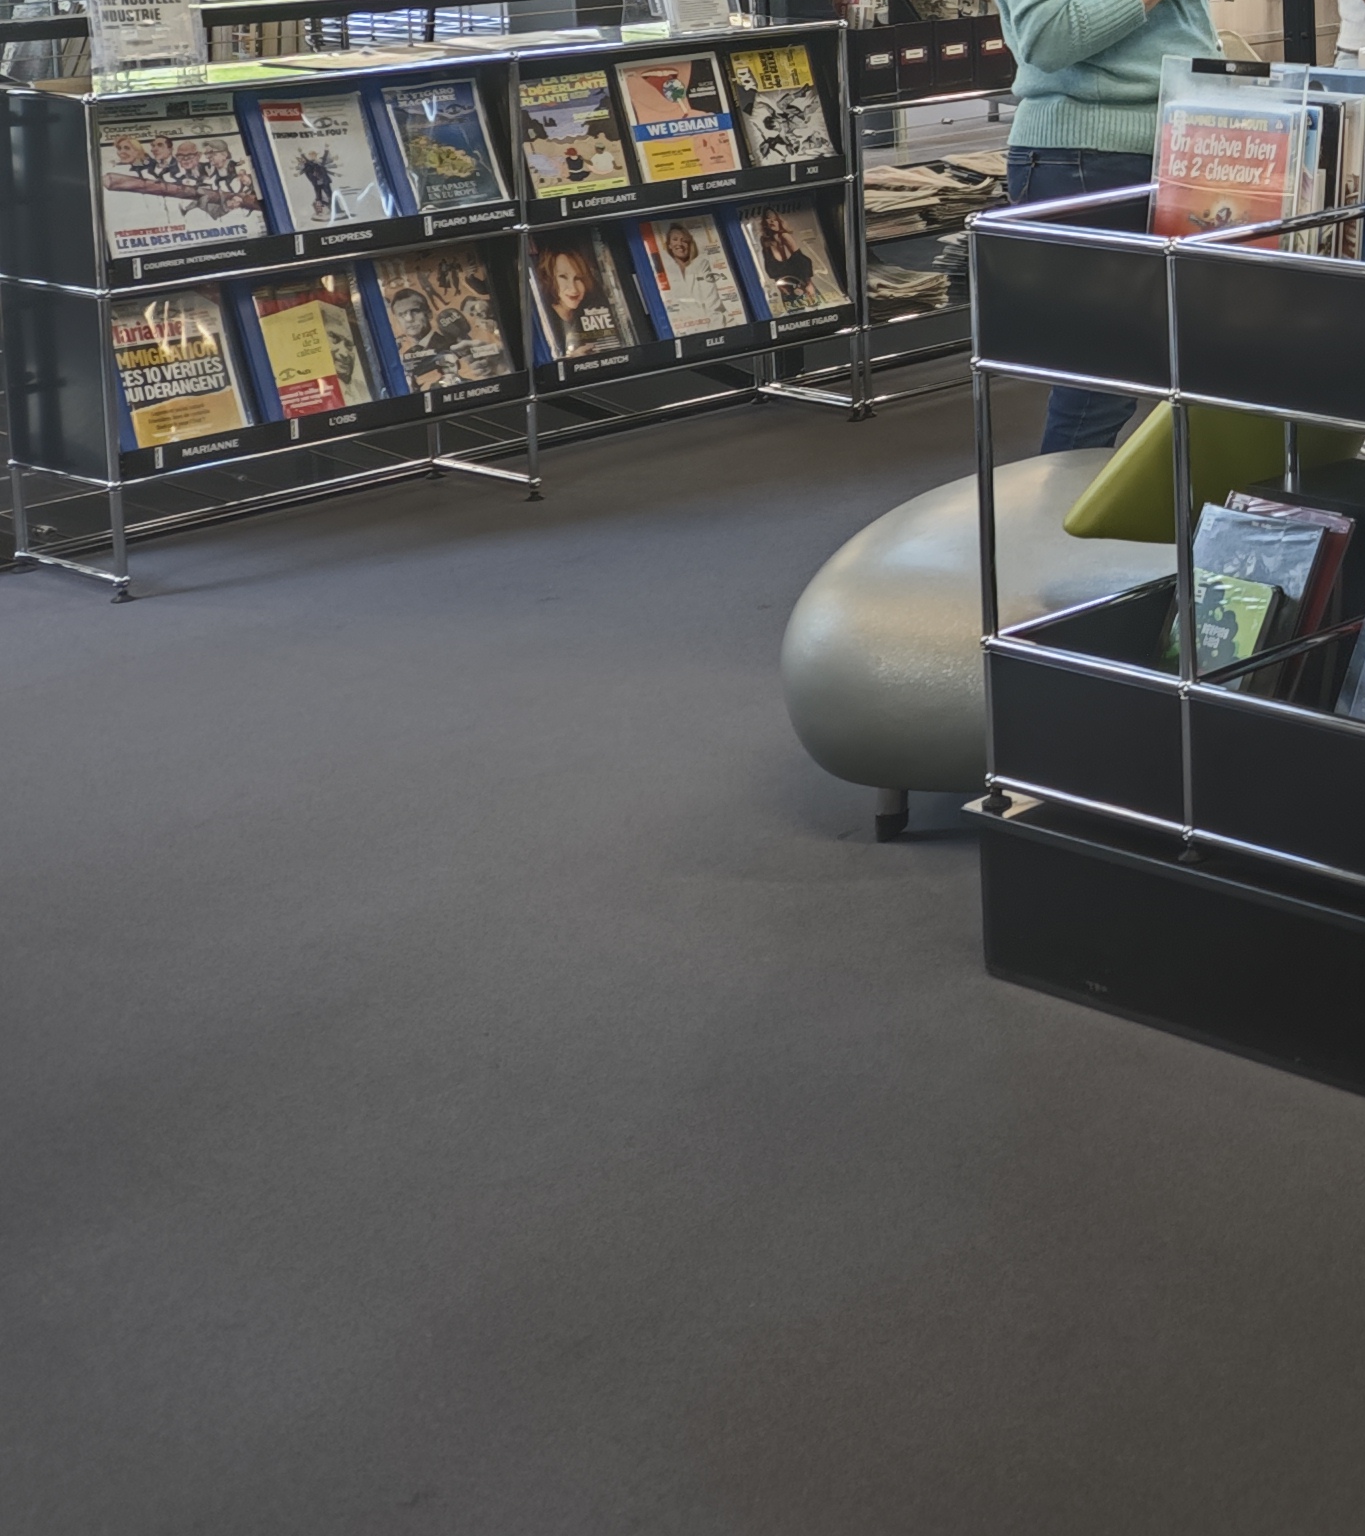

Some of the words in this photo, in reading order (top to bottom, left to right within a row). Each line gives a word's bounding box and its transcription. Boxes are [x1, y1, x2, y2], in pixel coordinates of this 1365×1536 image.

[646, 123, 668, 137] WE
[669, 116, 720, 134] DEMAIN
[1170, 131, 1190, 152] Un
[1193, 134, 1242, 158] achève
[1245, 136, 1277, 161] bien
[805, 166, 819, 175] XXI
[1168, 154, 1189, 176] les
[1191, 156, 1202, 178] 2
[1204, 159, 1262, 185] chevaux
[691, 183, 704, 192] WE
[705, 177, 737, 190] DEMAIN
[572, 199, 584, 209] LA
[585, 192, 637, 208] DÉFERLANTE
[433, 216, 467, 230] FIGARO
[468, 208, 515, 224] MAGAZINE
[321, 229, 373, 246] L'EXPRESS
[143, 258, 185, 271] COURRIER
[186, 249, 247, 265] INTERNATIONAL
[439, 312, 462, 328] Brut
[580, 313, 615, 332] BAYE
[778, 318, 811, 333] MADAME
[812, 313, 839, 327] FIGARO
[706, 336, 725, 347] ELLE
[163, 356, 223, 380] VÉRITÉS
[573, 361, 600, 373] PARIS
[600, 354, 630, 368] MATCH
[145, 372, 225, 401] DÉRANGENT
[453, 390, 465, 402] LE
[466, 384, 500, 399] MONDE
[329, 413, 357, 427] L'OBS
[182, 438, 240, 457] MARIANNE
